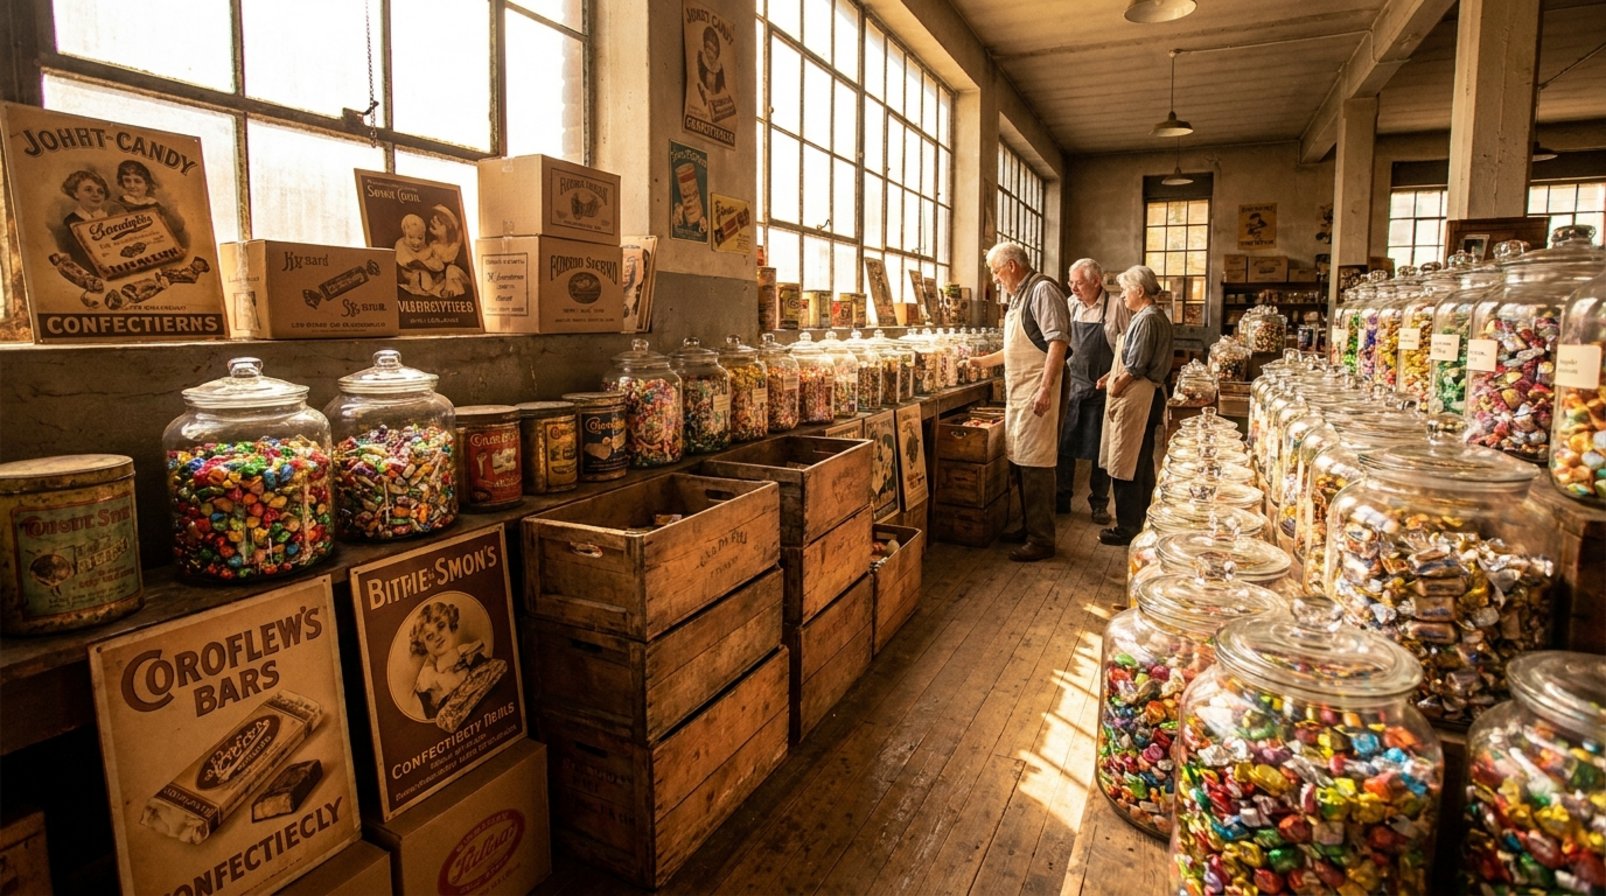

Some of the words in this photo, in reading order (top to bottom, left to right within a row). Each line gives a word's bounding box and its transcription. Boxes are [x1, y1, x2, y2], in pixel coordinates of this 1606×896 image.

[47, 316, 218, 335] CONFECTIERNS
[121, 606, 323, 713] COROFLEW'S
[193, 660, 280, 718] BARS
[163, 796, 343, 896] ONFECTIECLY
